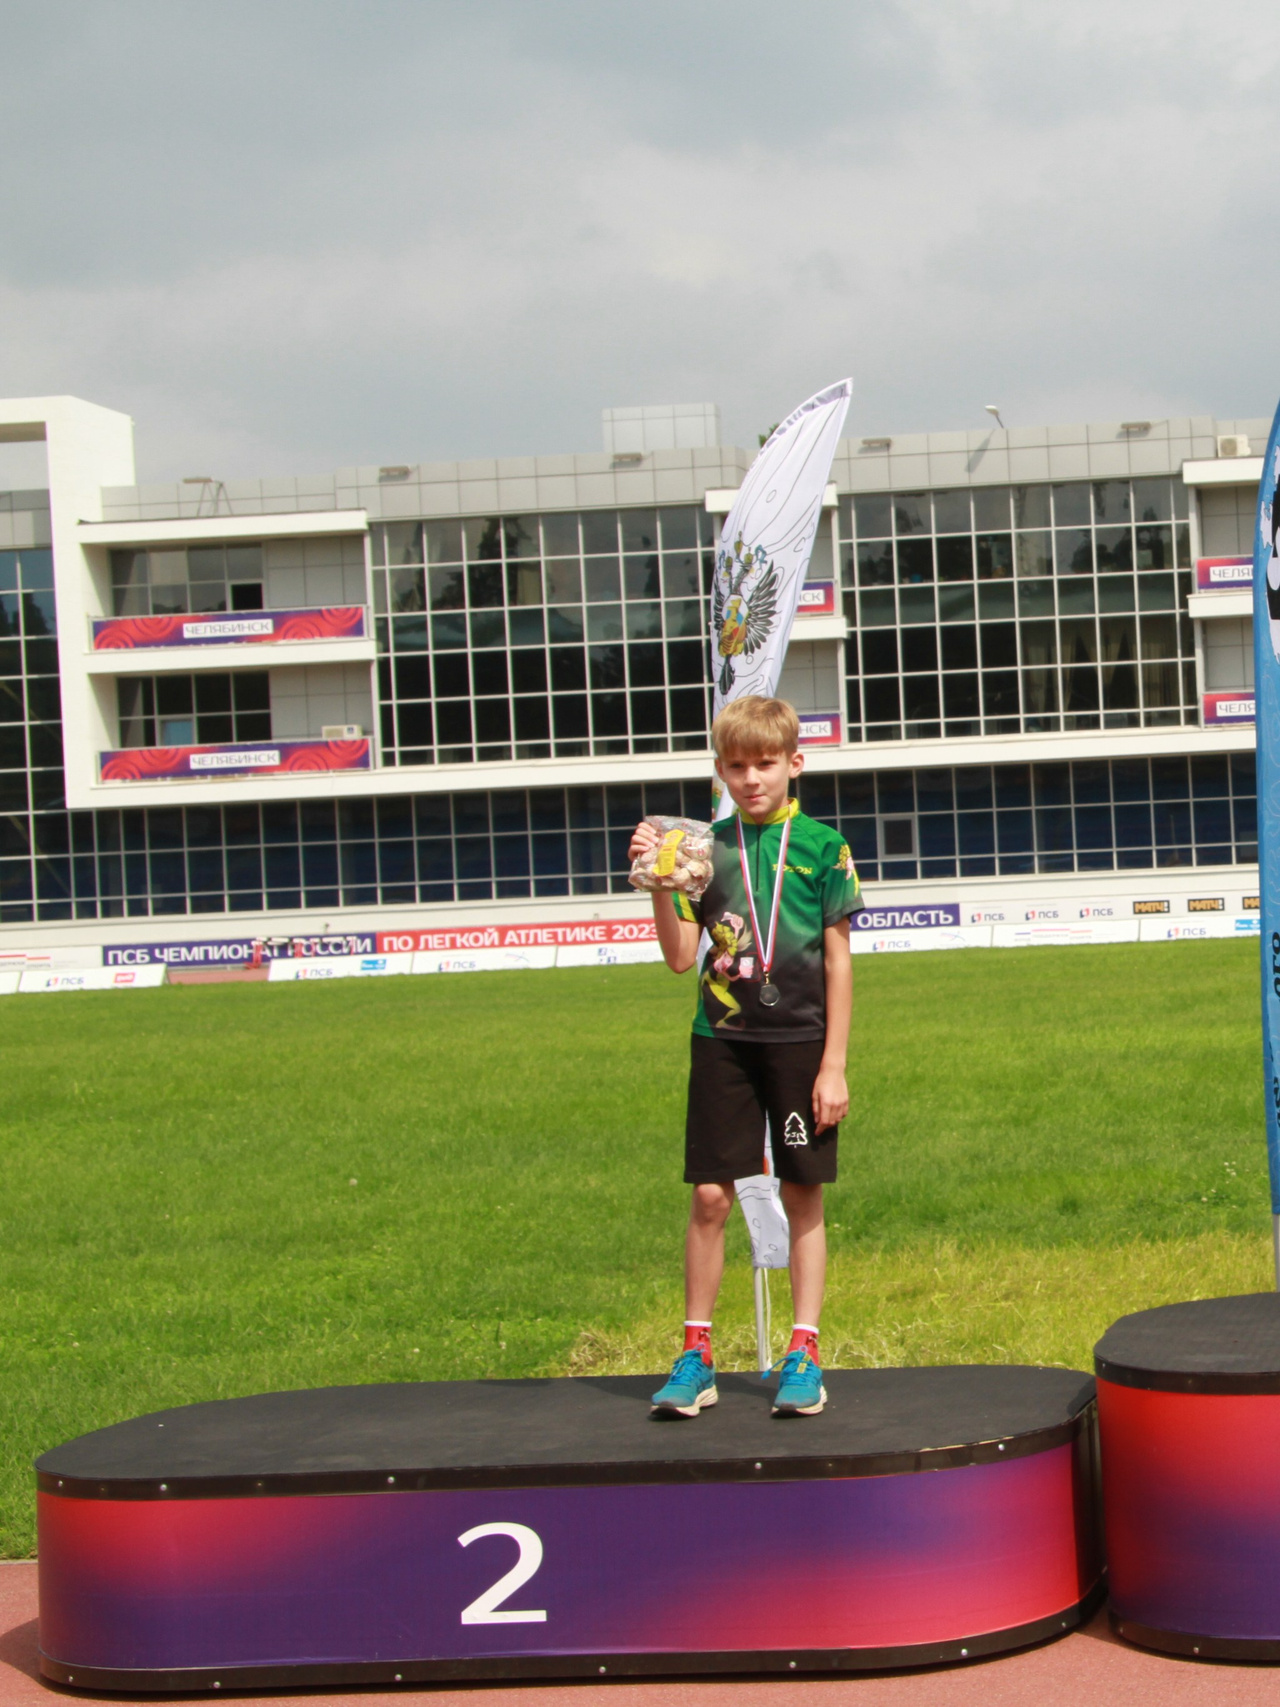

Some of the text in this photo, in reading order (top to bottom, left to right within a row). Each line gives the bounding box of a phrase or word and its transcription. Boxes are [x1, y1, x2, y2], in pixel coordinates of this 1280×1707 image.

[185, 621, 270, 635] ЧЕЛЯБИНСК
[191, 752, 277, 767] ЧЕЛЯБИНСК
[1038, 910, 1059, 919] ПСБ
[1092, 907, 1113, 917] ПСБ
[856, 909, 954, 929] ОБЛАСТЬ
[984, 913, 1005, 922] ПСБ
[1182, 927, 1206, 936] ПСБ
[383, 935, 414, 952] ПО
[418, 927, 500, 950] ЛЕГКОЙ
[504, 925, 608, 945] АТЛЕТИКЕ
[887, 940, 911, 949] ПСБ
[108, 949, 149, 966] ПСБ
[452, 960, 476, 969] ПСБ
[310, 968, 333, 977] ПСБ
[61, 976, 85, 985] ПСБ
[457, 1521, 547, 1626] 2
